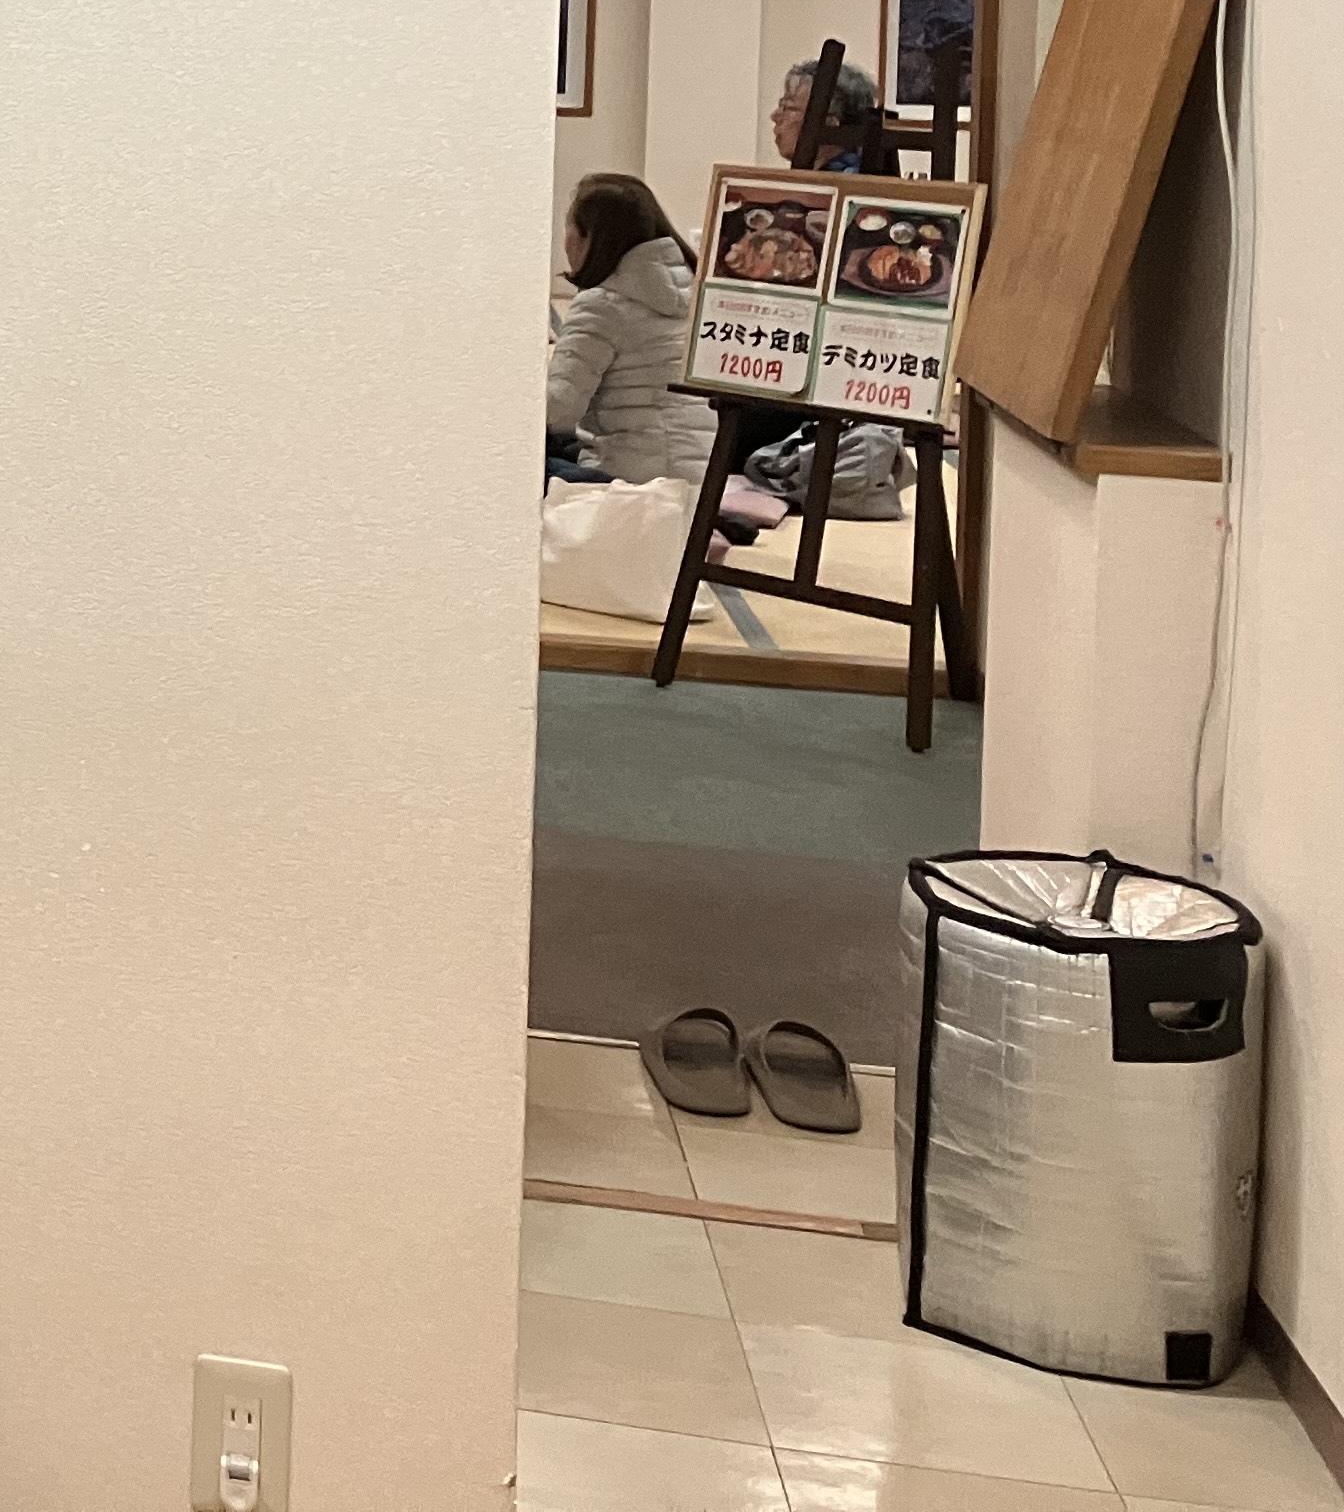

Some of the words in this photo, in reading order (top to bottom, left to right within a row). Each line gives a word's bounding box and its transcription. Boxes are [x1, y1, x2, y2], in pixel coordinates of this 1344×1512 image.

[700, 320, 811, 355] スタミナ定食
[719, 352, 784, 383] 1200円
[821, 343, 941, 380] デミカツ定食
[844, 379, 911, 410] 1200円
